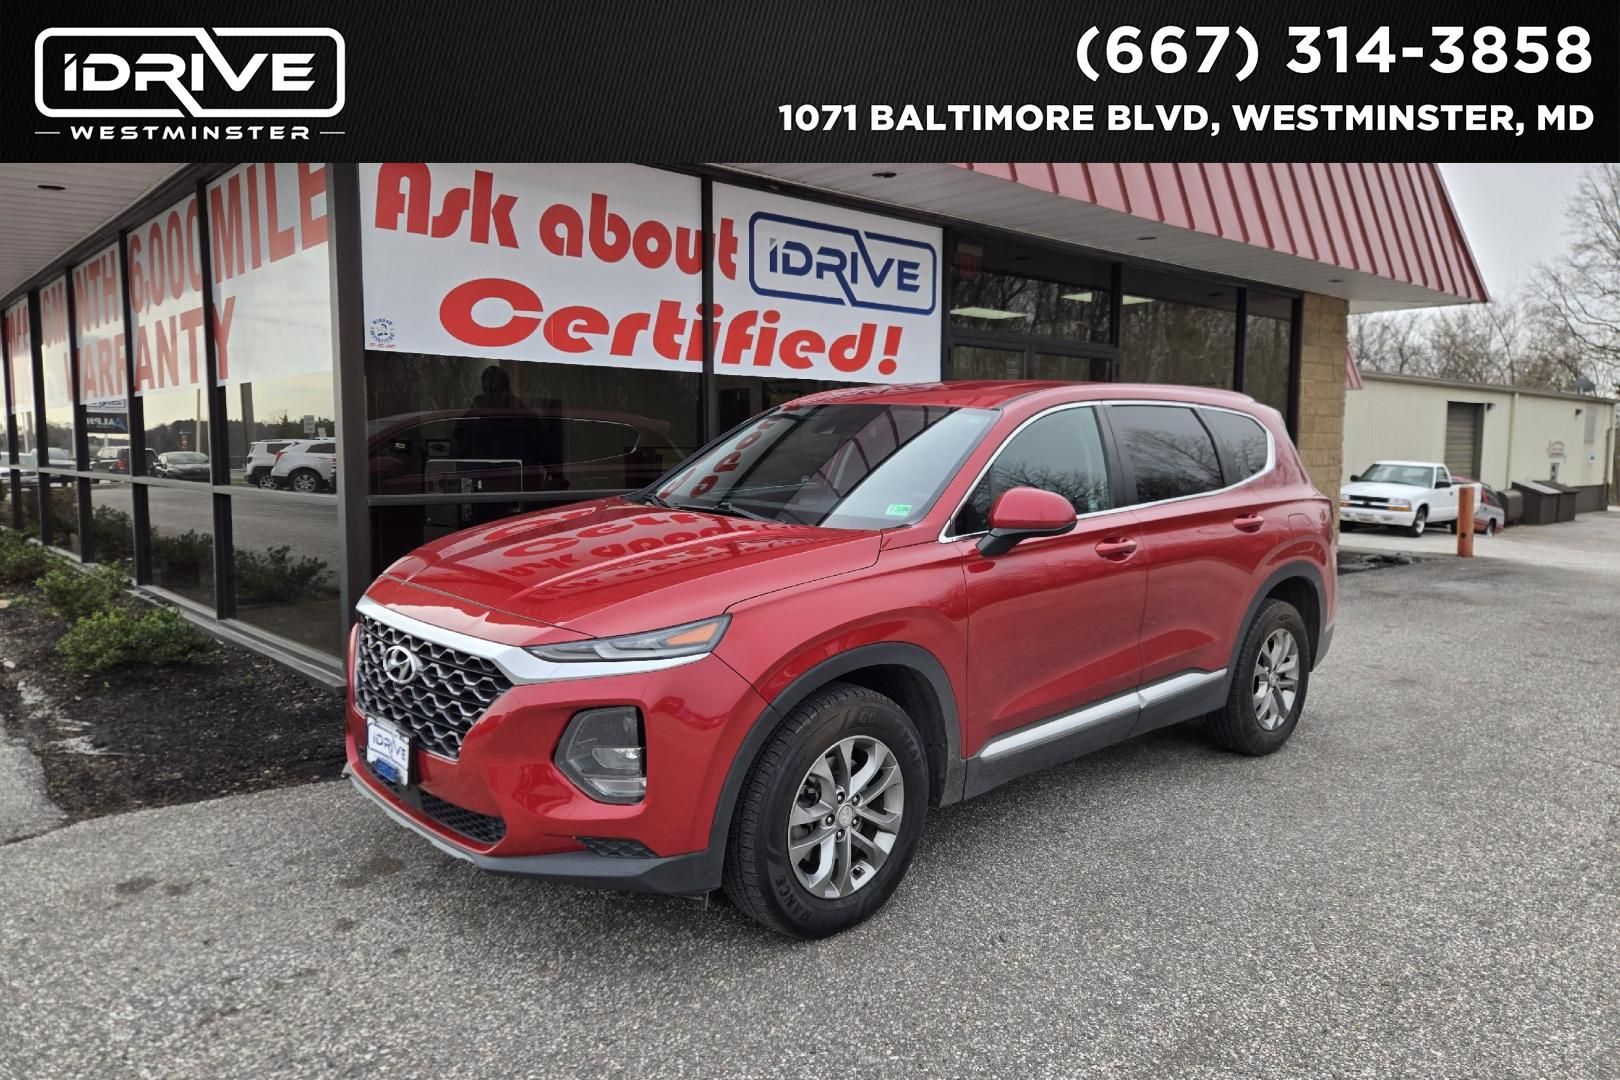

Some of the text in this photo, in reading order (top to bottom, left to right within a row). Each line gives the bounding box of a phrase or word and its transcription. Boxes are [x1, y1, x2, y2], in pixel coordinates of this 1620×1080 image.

[211, 163, 328, 284] MILE
[375, 163, 519, 249] Ask
[539, 192, 738, 281] about
[439, 278, 903, 376] Certified!
